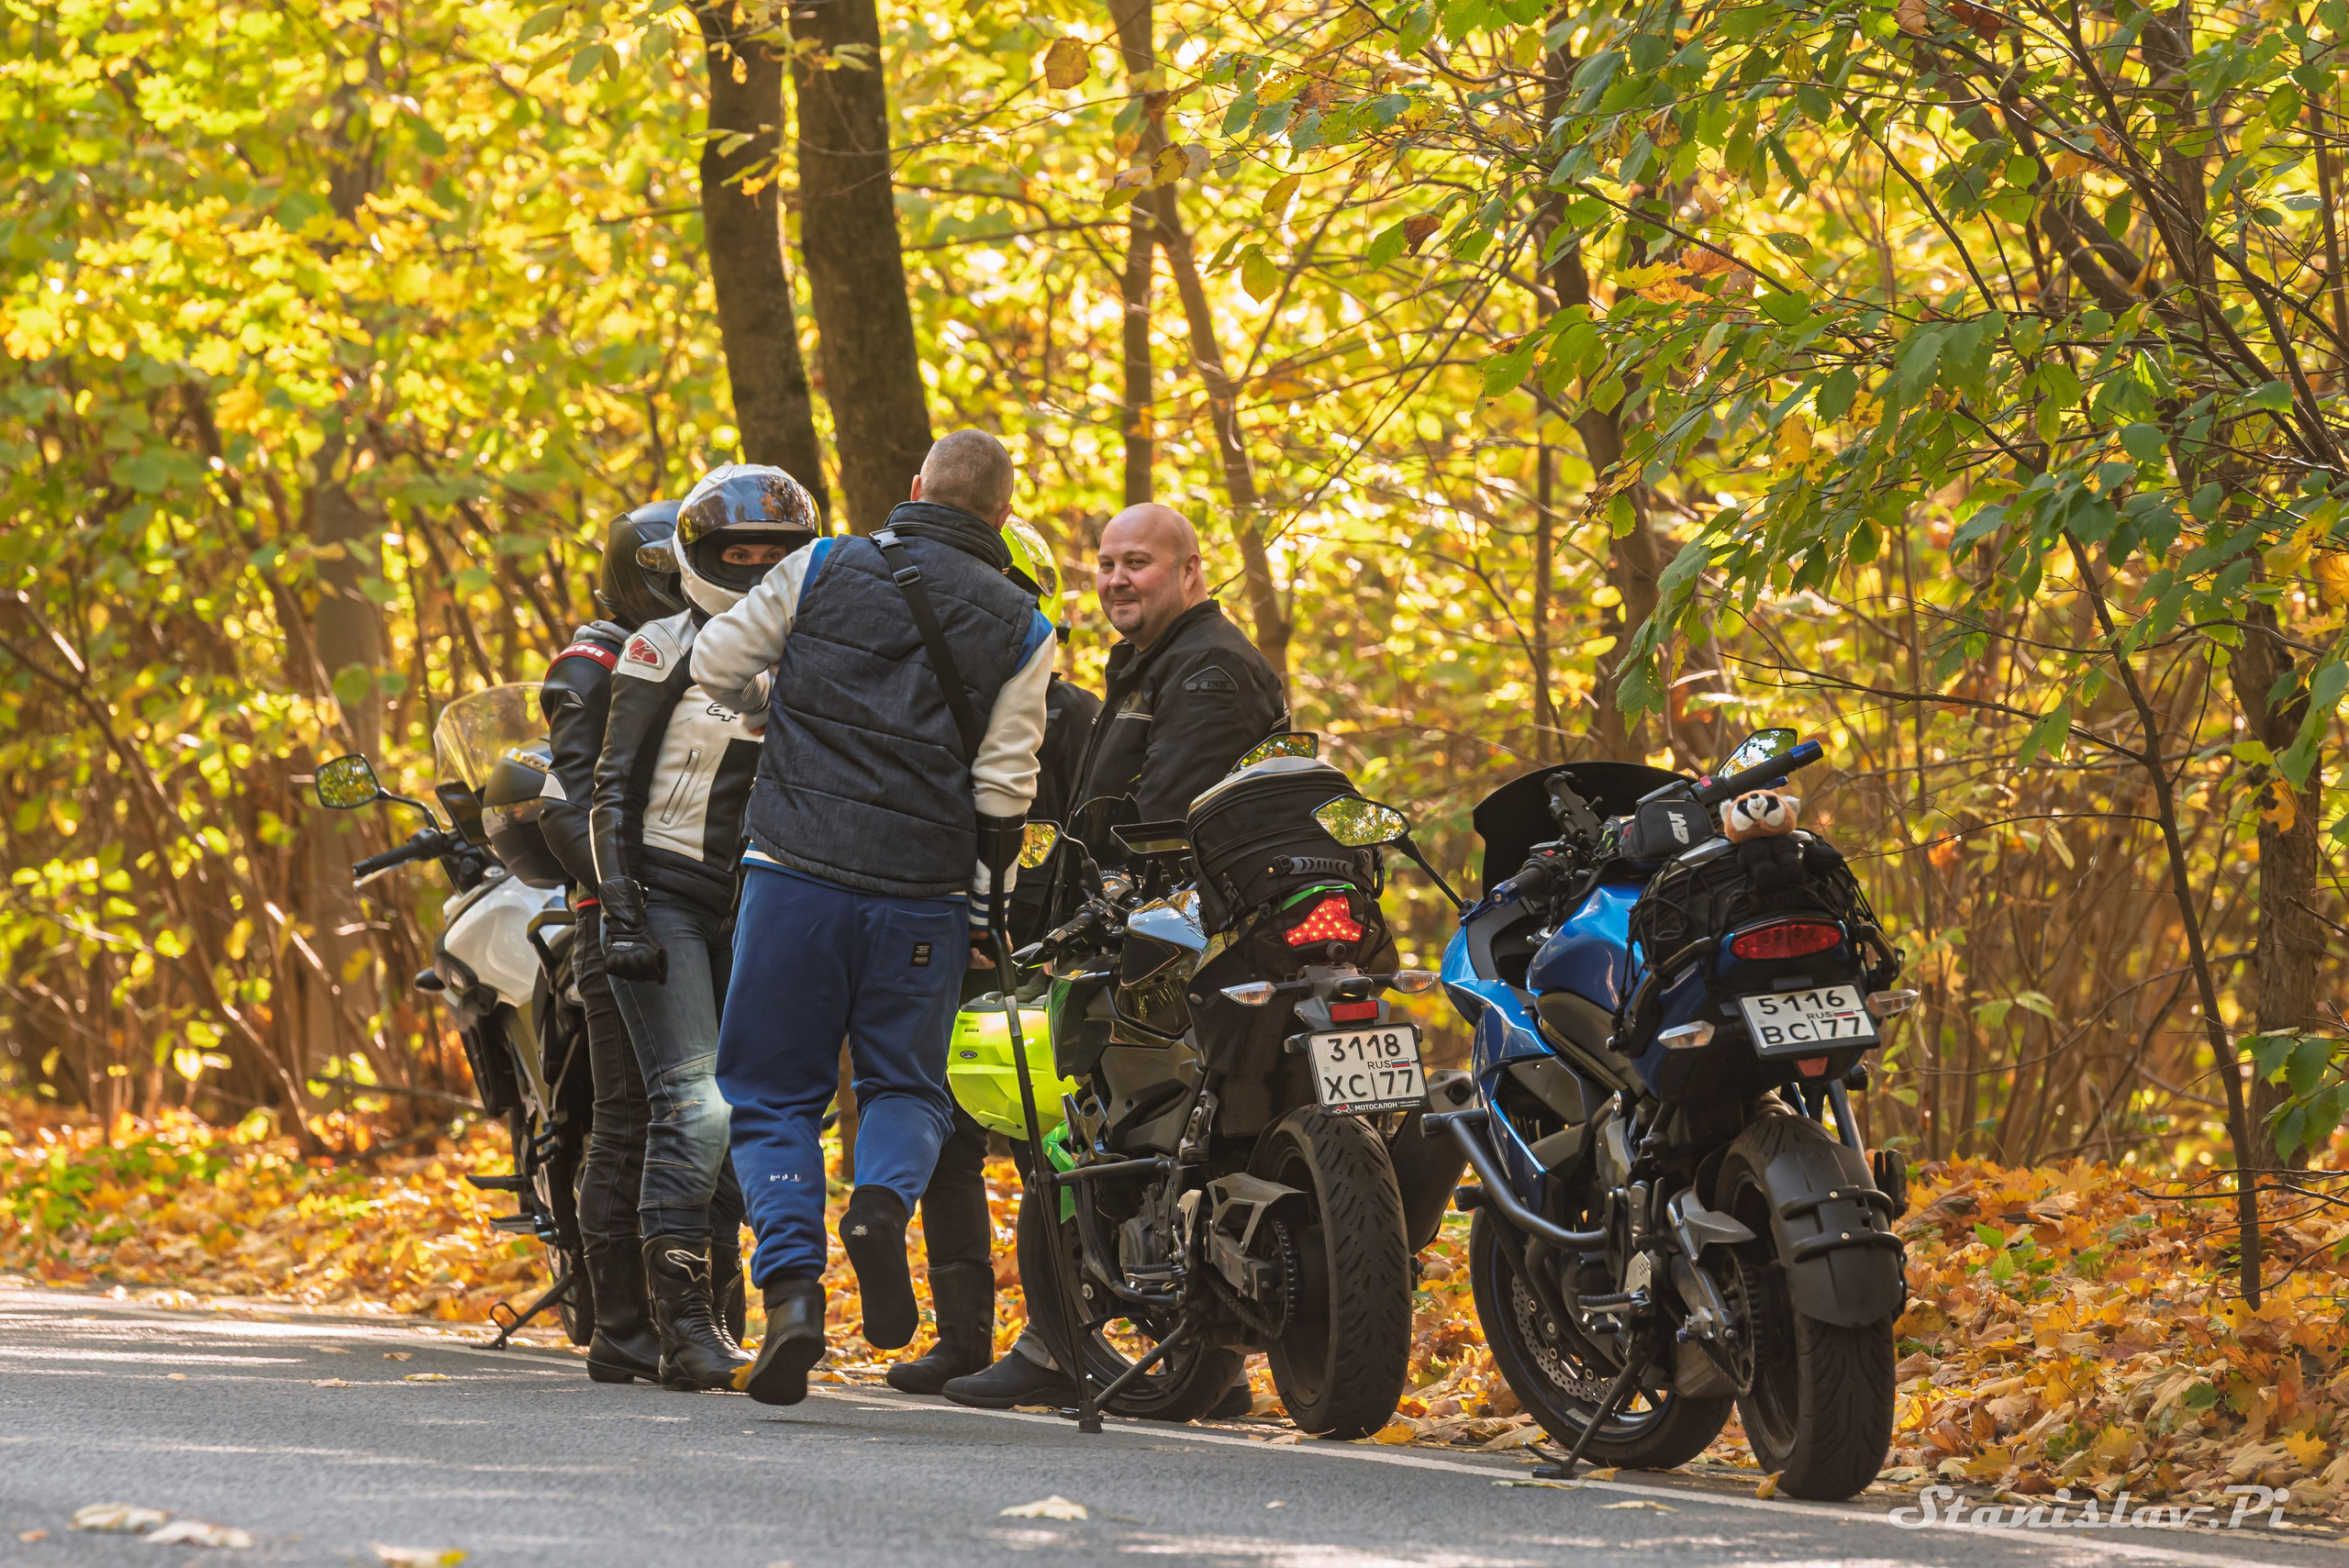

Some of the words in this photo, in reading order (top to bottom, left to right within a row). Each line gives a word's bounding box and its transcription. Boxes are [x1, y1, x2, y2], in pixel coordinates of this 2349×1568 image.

[1666, 810, 1689, 844] GIVI
[1757, 990, 1845, 1015] 5116
[1806, 1011, 1834, 1020] RUS
[1820, 1017, 1860, 1038] 77
[1327, 1033, 1401, 1062] 3118
[1367, 1060, 1392, 1070] RUS
[1379, 1069, 1413, 1095] 77
[1354, 1102, 1397, 1111] МОТОСАЛОН
